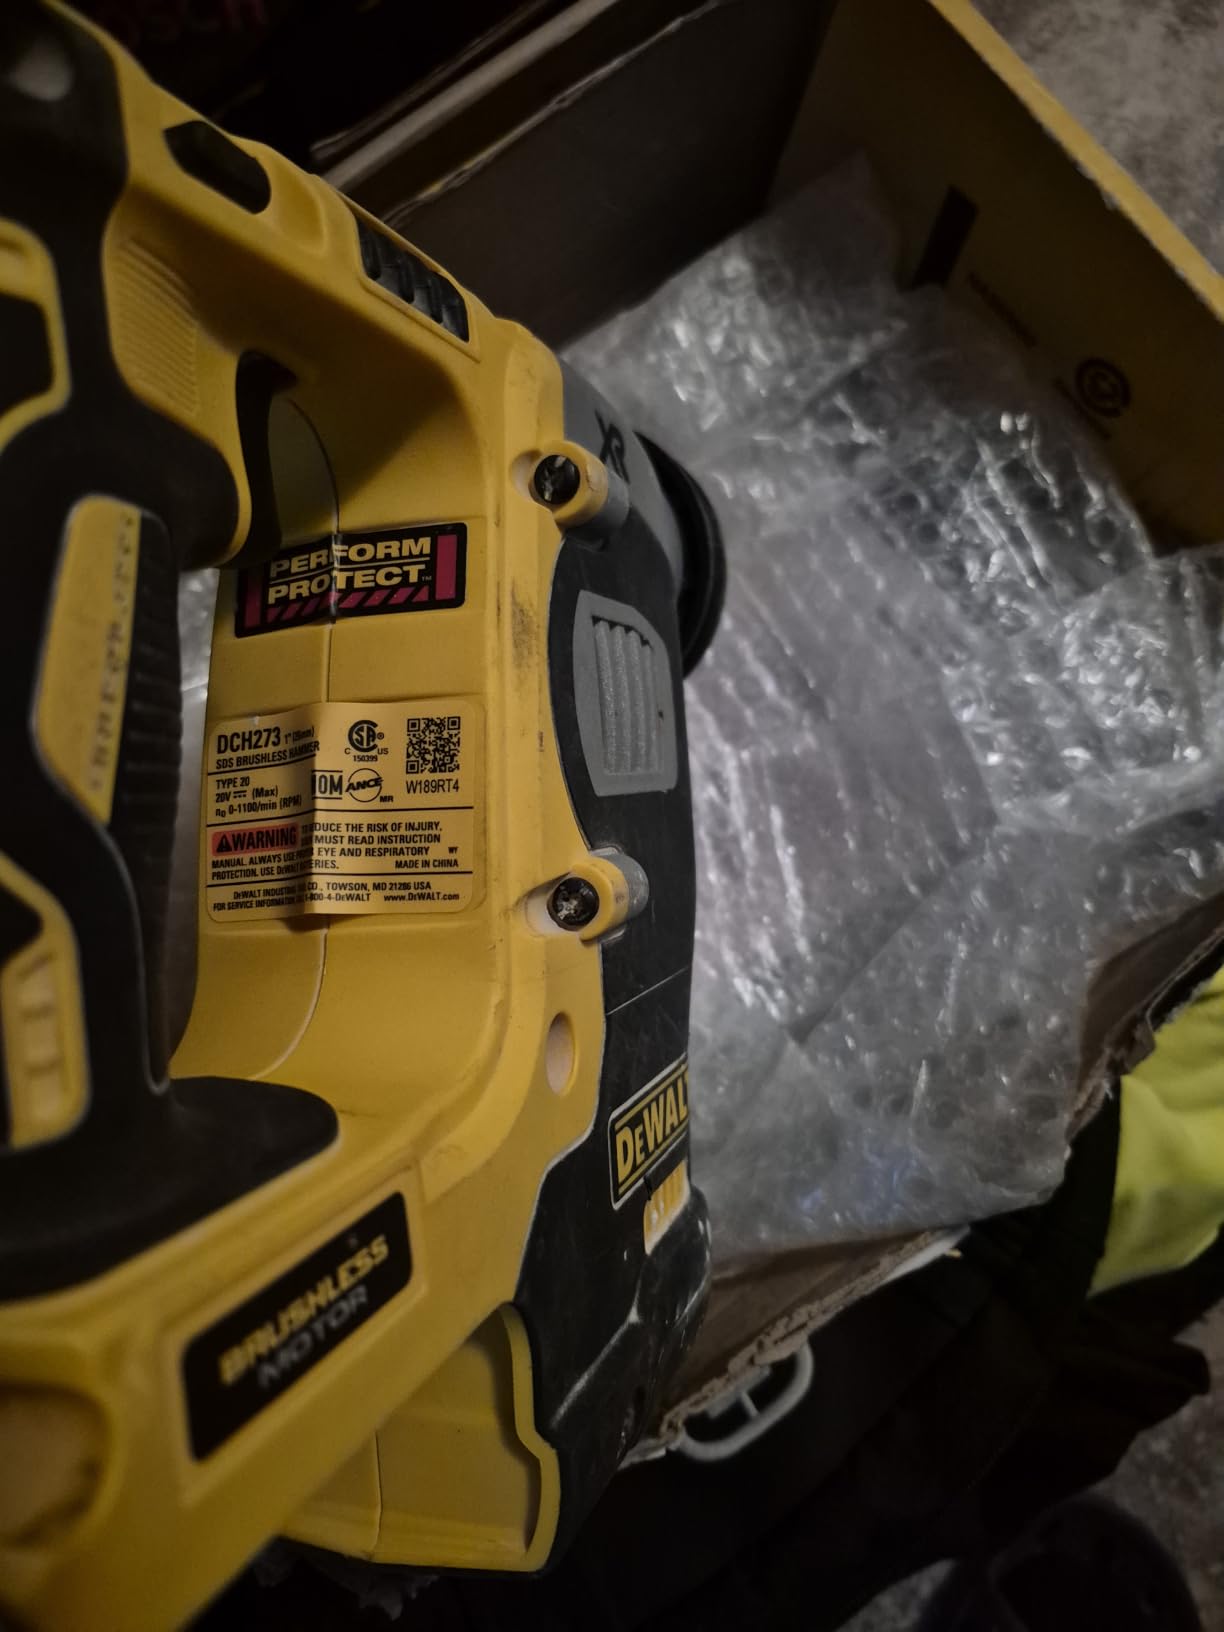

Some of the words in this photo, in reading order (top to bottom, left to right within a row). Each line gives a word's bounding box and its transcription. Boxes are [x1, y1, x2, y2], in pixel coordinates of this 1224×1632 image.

[270, 537, 431, 578] PERFORM
[268, 564, 426, 604] PROTECT
[216, 726, 281, 754] DCH273
[216, 758, 234, 770] SDS
[236, 750, 287, 767] BRUSHLESS
[216, 777, 239, 789] TYPE
[240, 776, 250, 787] 20
[406, 778, 460, 794] W189RT4
[215, 791, 231, 803] 20V
[252, 785, 278, 799] (Max)
[228, 800, 277, 815] 0-1100/min
[231, 826, 297, 851] WARNING
[345, 823, 364, 832] THE
[366, 822, 388, 832] RISK
[391, 822, 403, 832] OF
[405, 821, 442, 832] INJURY.
[314, 835, 344, 845] MUST
[347, 835, 374, 845] READ
[377, 834, 441, 845] INSTRUCTION
[212, 859, 248, 870] MANUAL.
[249, 854, 282, 867] ALWAYS
[317, 847, 336, 857] EYE
[339, 847, 362, 857] AND
[365, 846, 430, 857] RESPIRATORY
[395, 859, 419, 869] MADE
[421, 859, 430, 868] IN
[432, 858, 459, 868] CHINA
[212, 868, 259, 880] PROTECTION.
[261, 866, 275, 876] USE
[326, 882, 370, 892] TOWSON,
[372, 882, 387, 891] MD
[413, 881, 432, 890] USA
[213, 902, 226, 912] FOR
[227, 899, 254, 911] SERVICE
[615, 1070, 688, 1185] DEWAL
[218, 1234, 389, 1387] BRUSHLESS
[258, 1284, 368, 1389] MOTOR
